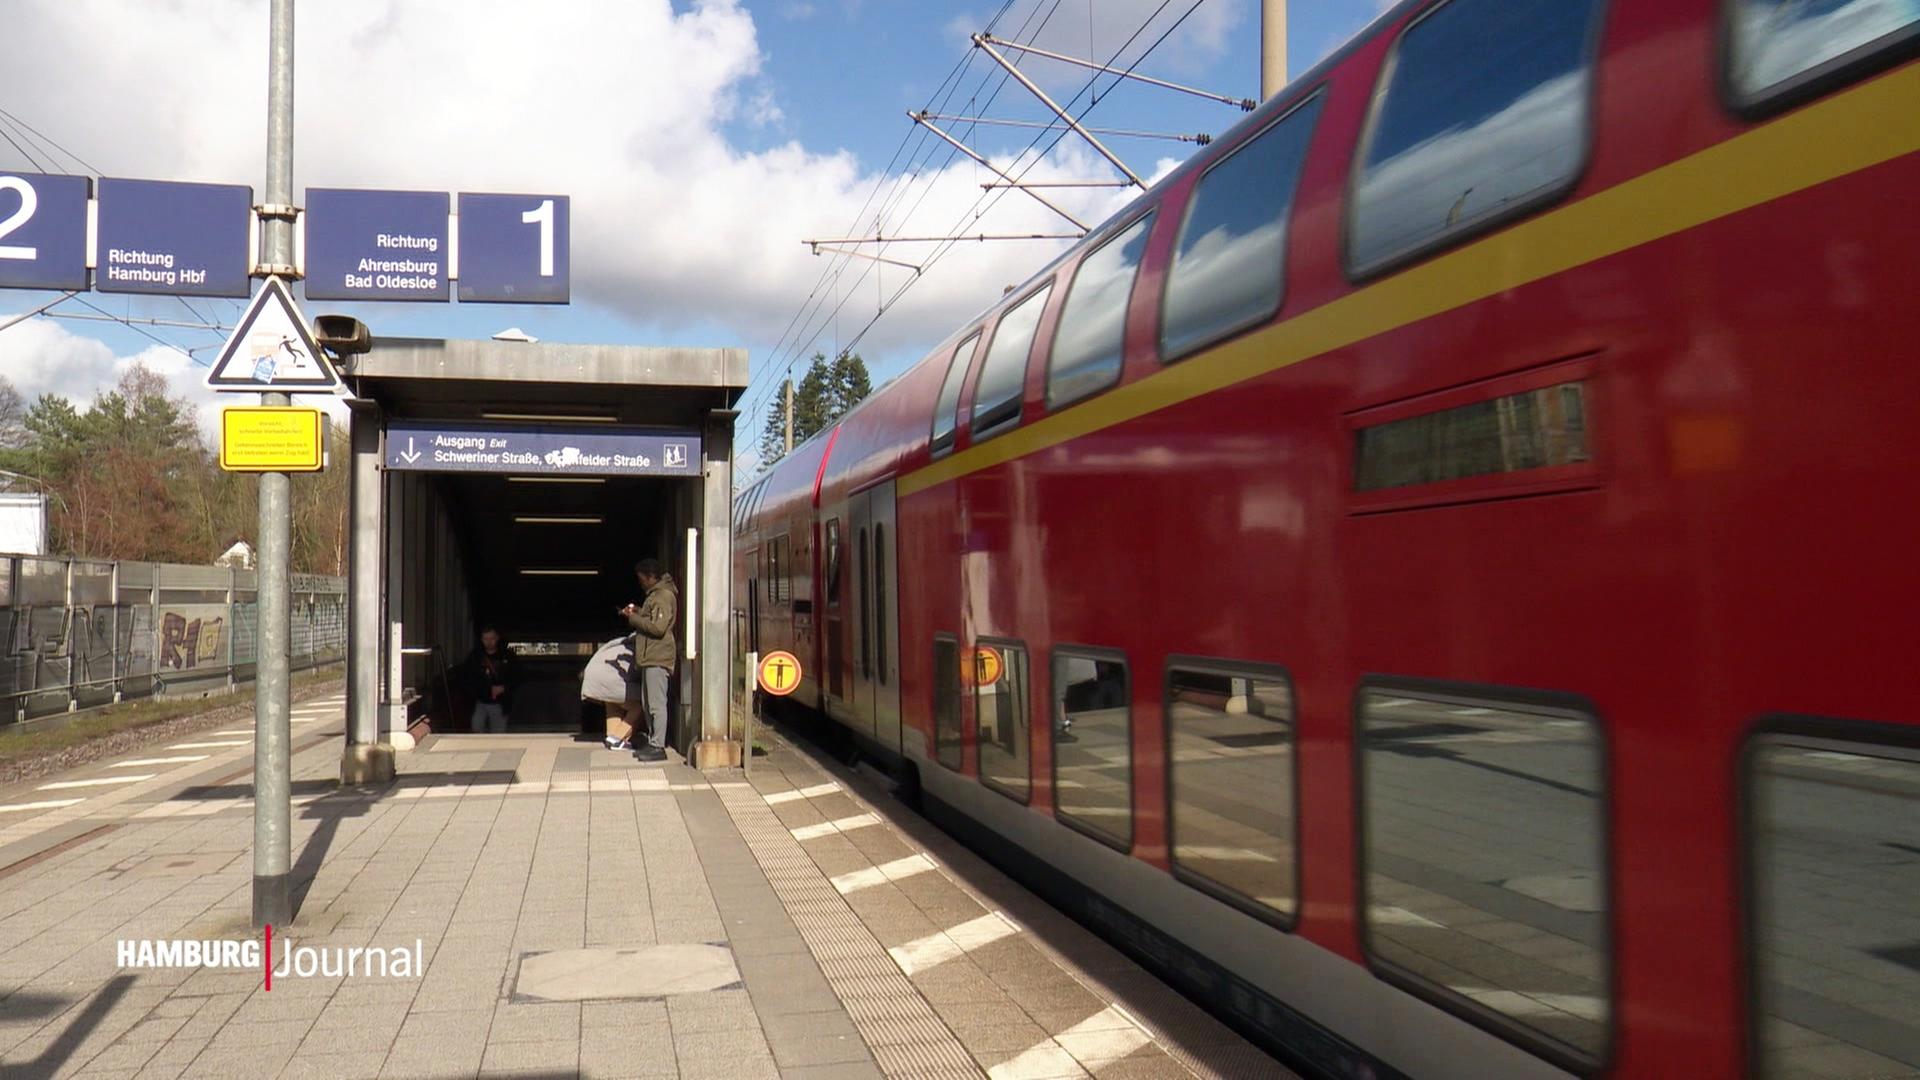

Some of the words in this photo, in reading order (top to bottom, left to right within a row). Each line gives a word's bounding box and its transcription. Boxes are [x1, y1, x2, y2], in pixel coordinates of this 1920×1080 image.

[0, 176, 37, 260] 2
[377, 234, 437, 252] Richtung
[522, 200, 554, 276] 1
[108, 249, 173, 267] Richtung
[358, 258, 437, 276] Ahrensburg
[108, 266, 175, 284] Hamburg
[180, 269, 206, 283] Hbf
[345, 275, 372, 288] Bad
[376, 275, 437, 289] Oldesloe
[435, 435, 485, 449] Ausgang
[489, 439, 507, 448] Exit
[434, 451, 498, 463] Schweriner
[502, 453, 542, 466] Straße,
[613, 455, 650, 467] Straße
